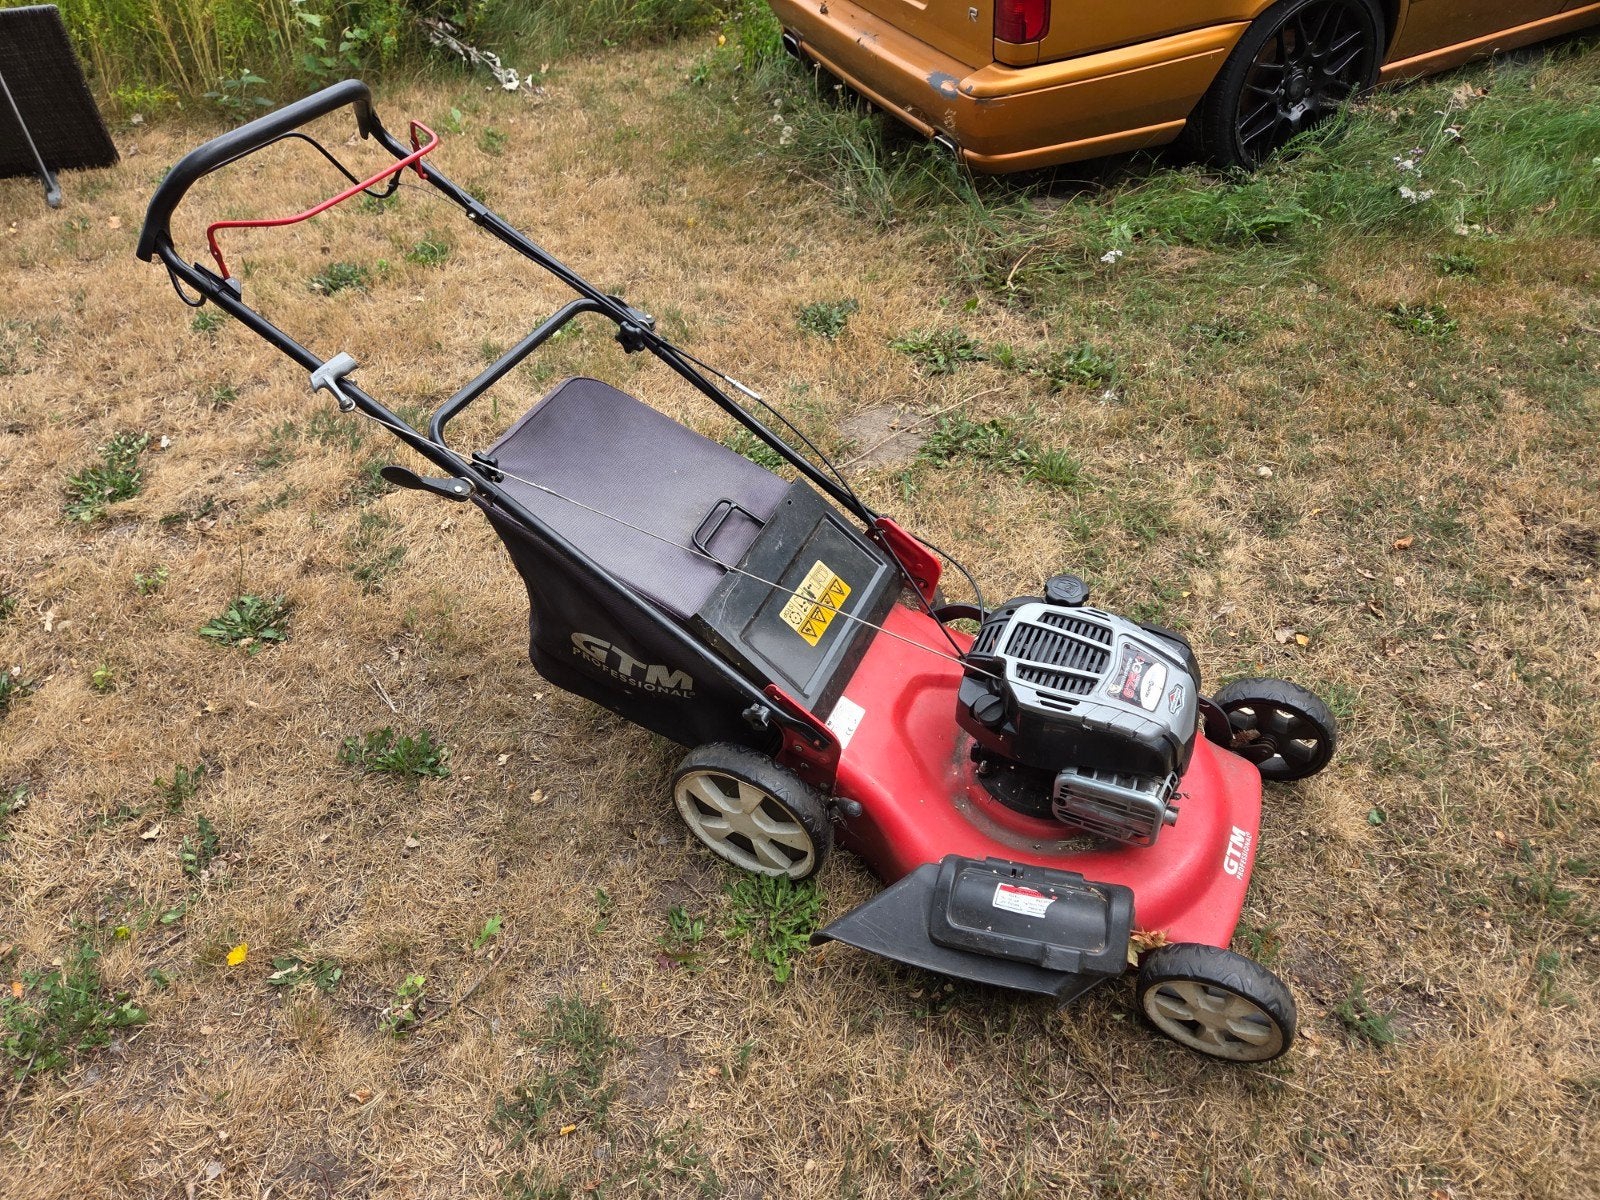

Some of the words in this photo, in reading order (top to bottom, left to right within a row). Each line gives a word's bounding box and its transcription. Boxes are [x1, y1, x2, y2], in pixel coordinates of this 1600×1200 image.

[969, 7, 978, 22] R
[571, 632, 694, 690] GTM
[572, 646, 692, 699] PROFESSIONAL
[1223, 825, 1247, 875] GTM
